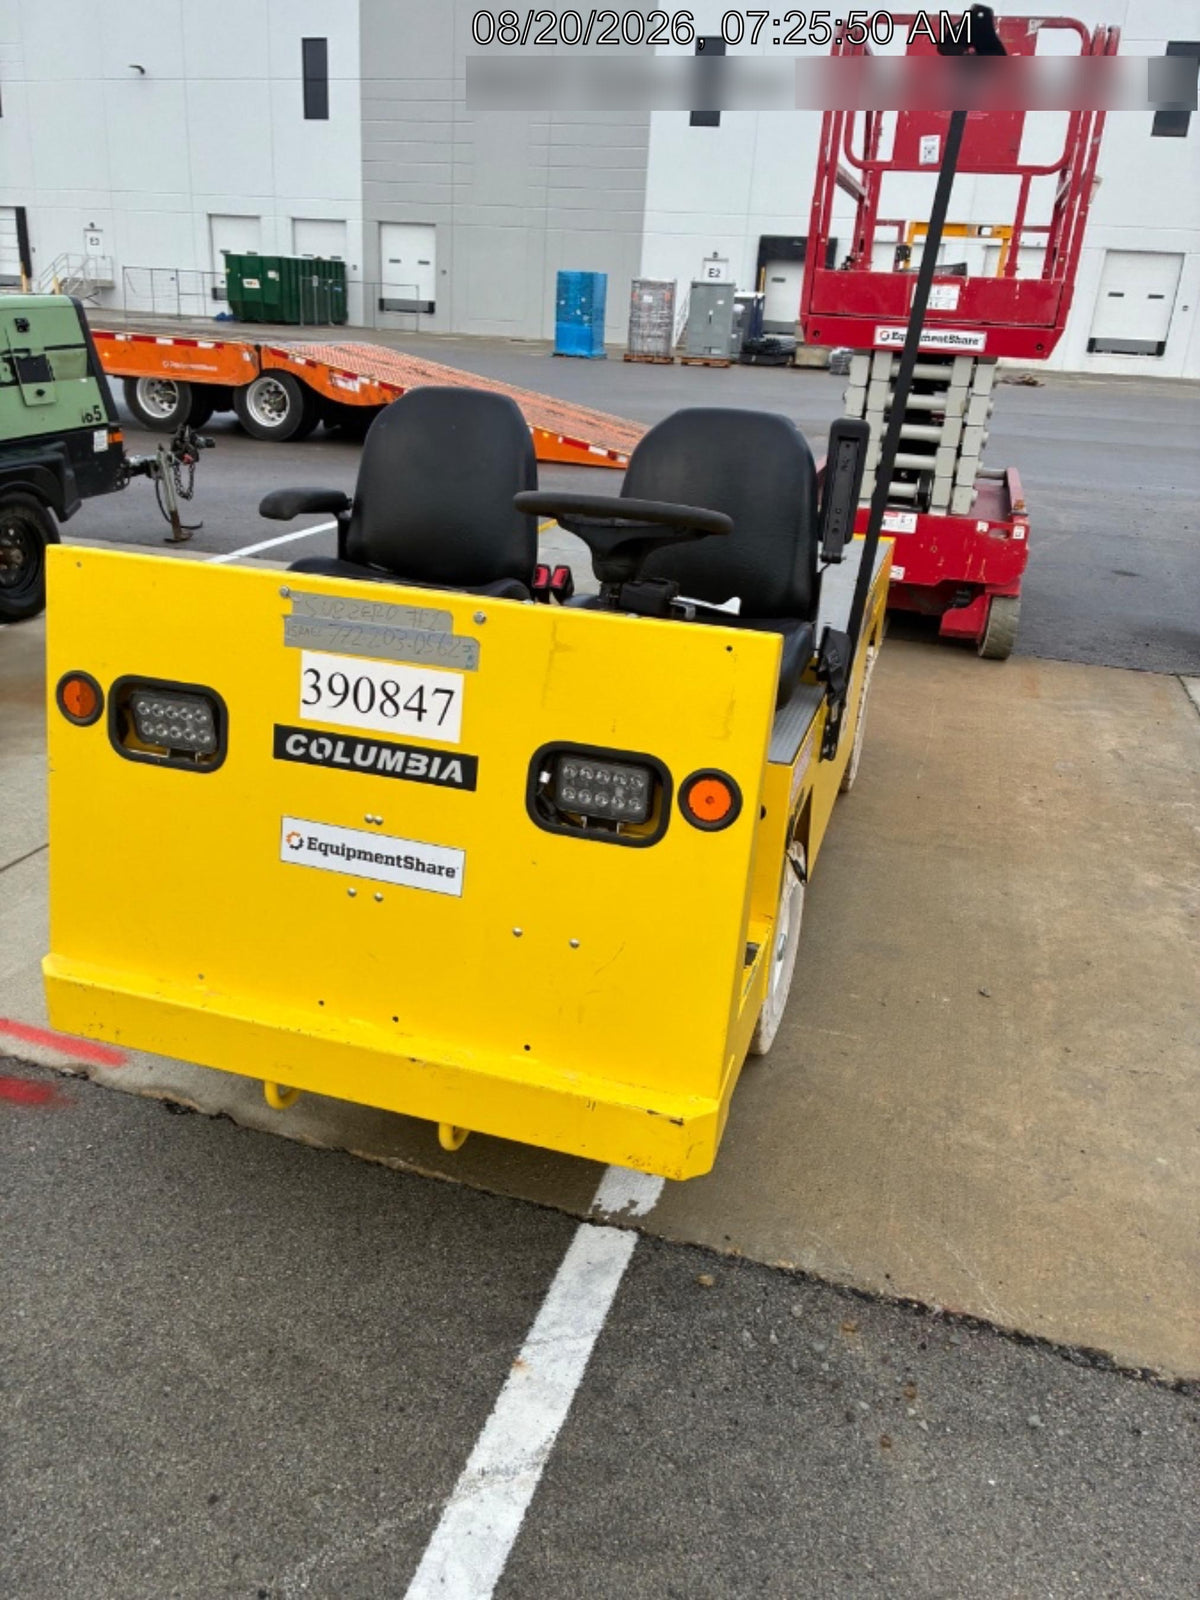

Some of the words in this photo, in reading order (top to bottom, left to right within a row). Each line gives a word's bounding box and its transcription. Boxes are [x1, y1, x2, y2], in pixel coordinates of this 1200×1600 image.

[708, 268, 721, 278] E2
[301, 667, 456, 727] 390847
[285, 733, 464, 784] COLUMBIA
[306, 836, 457, 879] EquipmentShare
